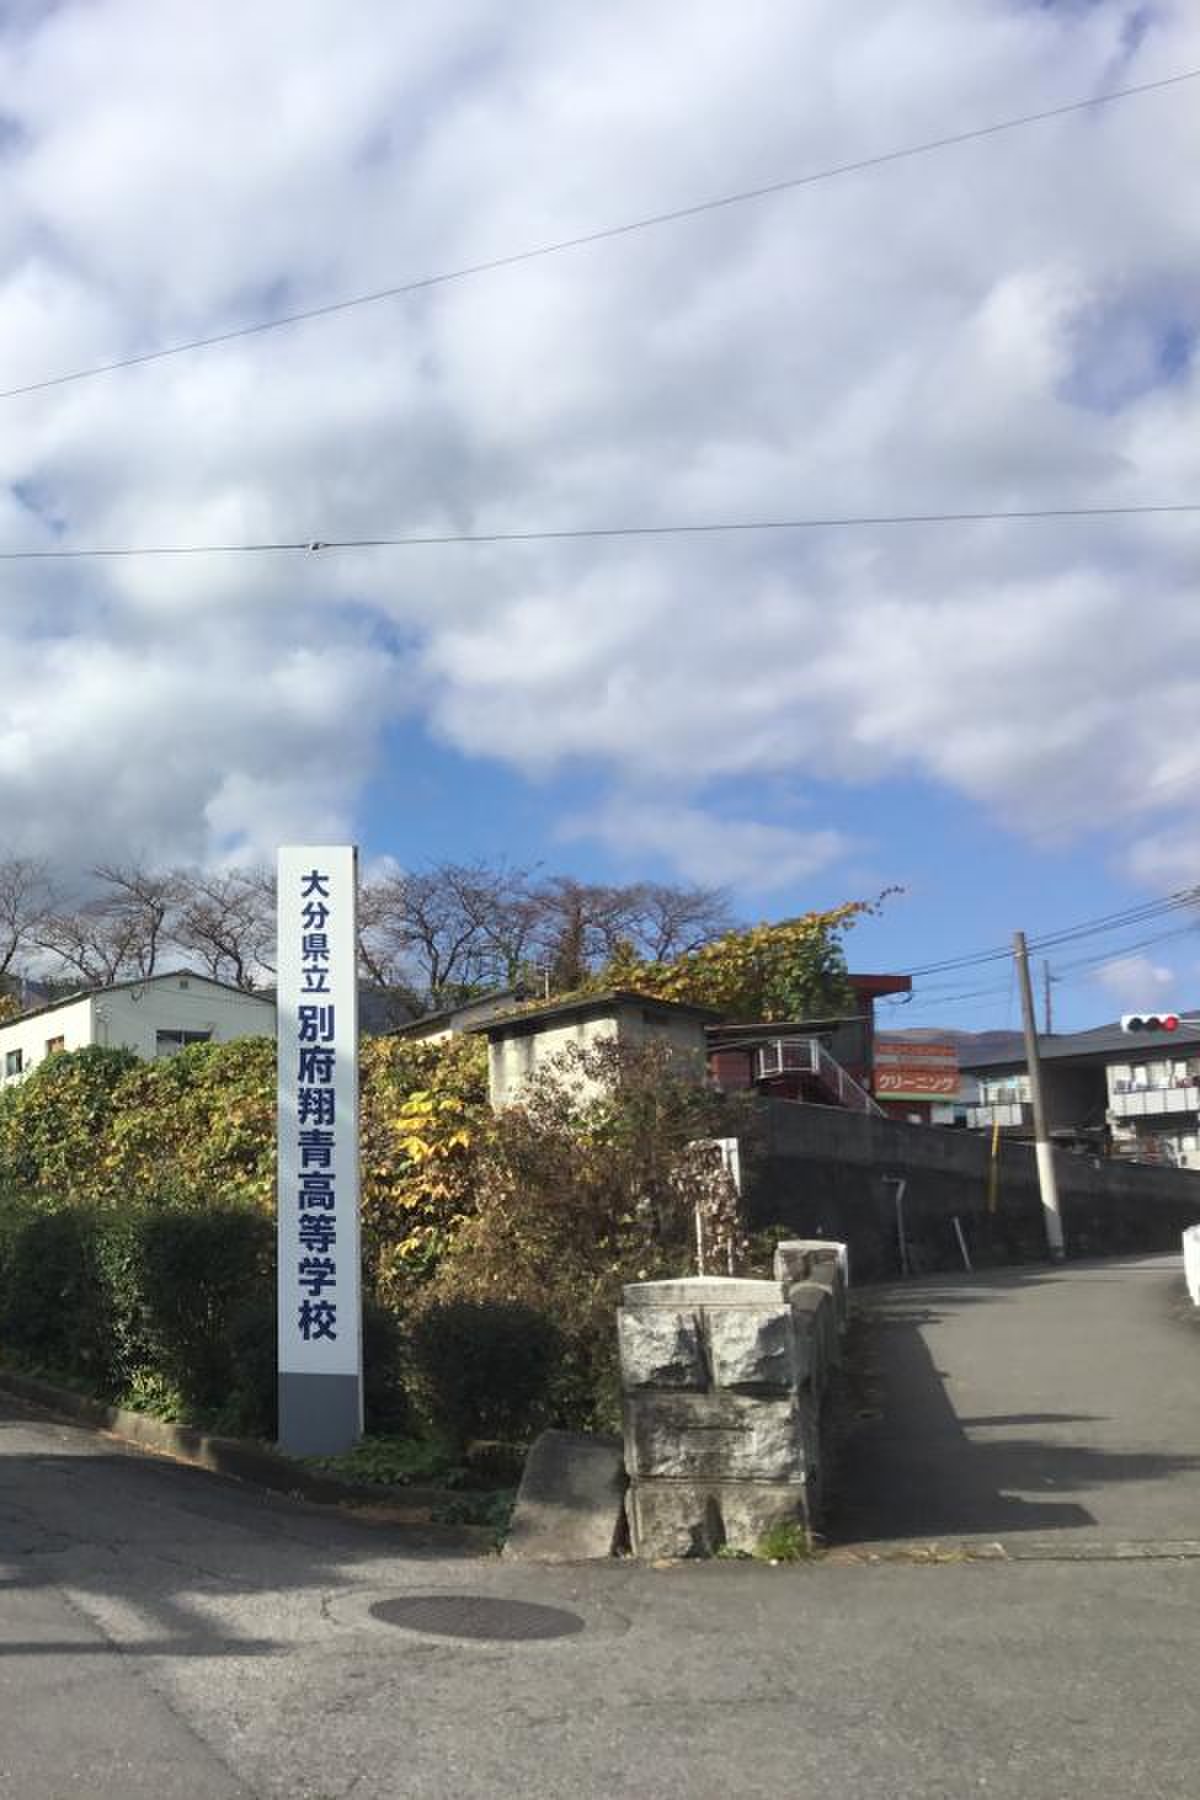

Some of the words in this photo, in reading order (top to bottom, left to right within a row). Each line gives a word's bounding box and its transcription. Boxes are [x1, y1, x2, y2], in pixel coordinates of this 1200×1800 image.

[300, 870, 331, 993] 大分県立
[879, 1073, 954, 1092] クリーニング
[297, 1005, 337, 1341] 別府翔青高等学校
